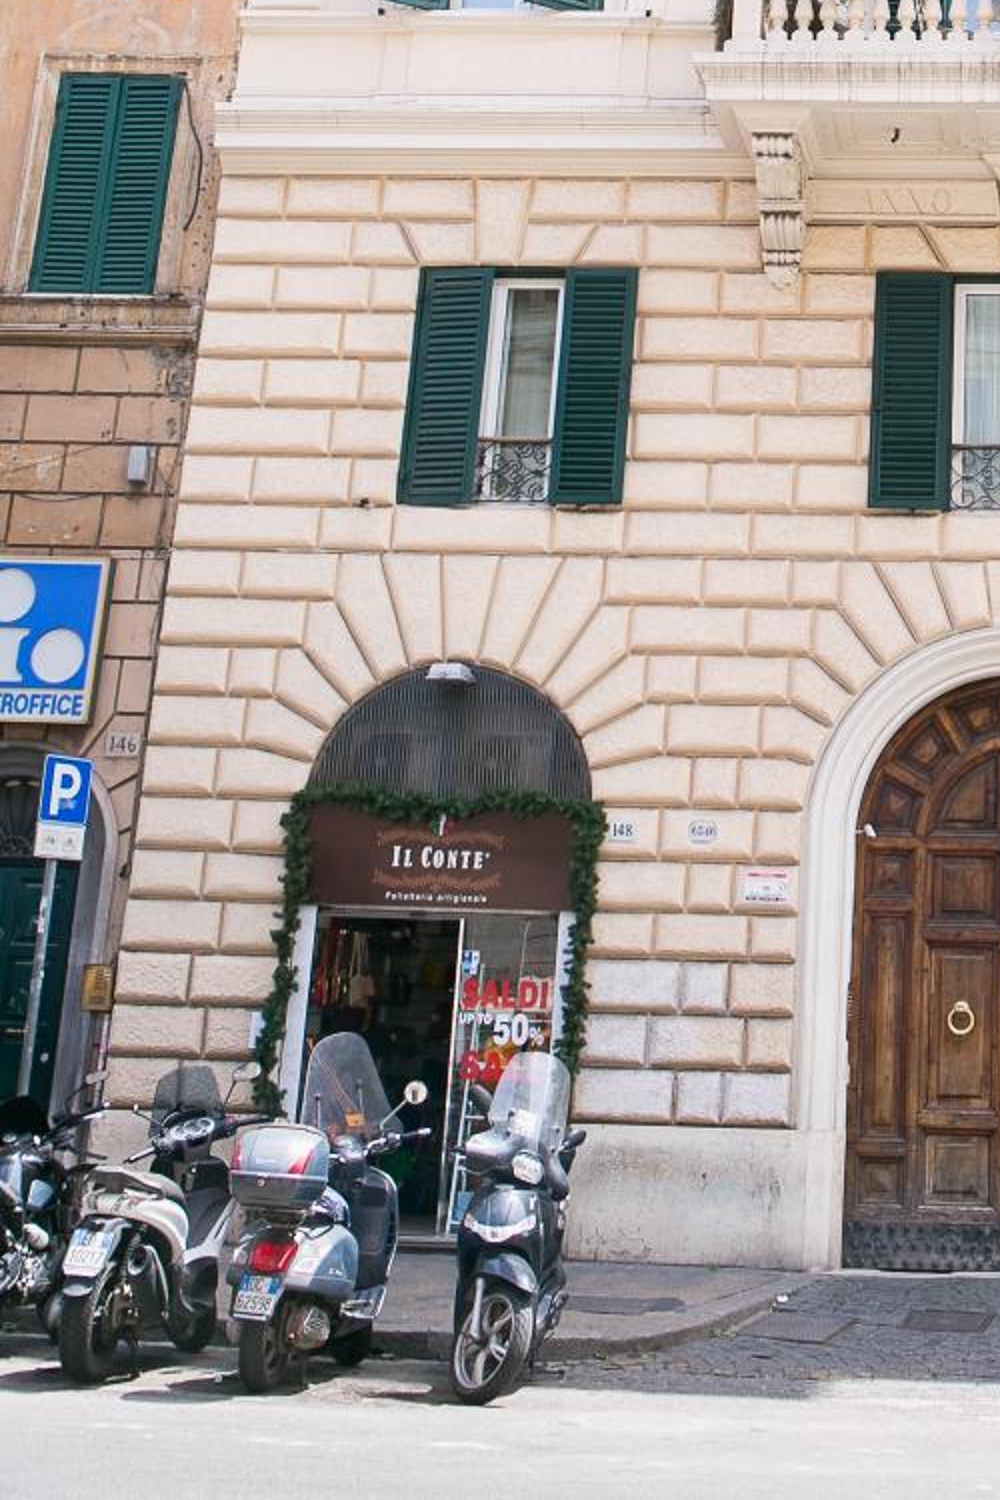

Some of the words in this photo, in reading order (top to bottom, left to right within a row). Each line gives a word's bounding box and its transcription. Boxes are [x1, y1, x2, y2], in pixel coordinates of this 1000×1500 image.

[109, 736, 137, 752] 146
[50, 763, 81, 816] P
[461, 977, 550, 1011] SALDI
